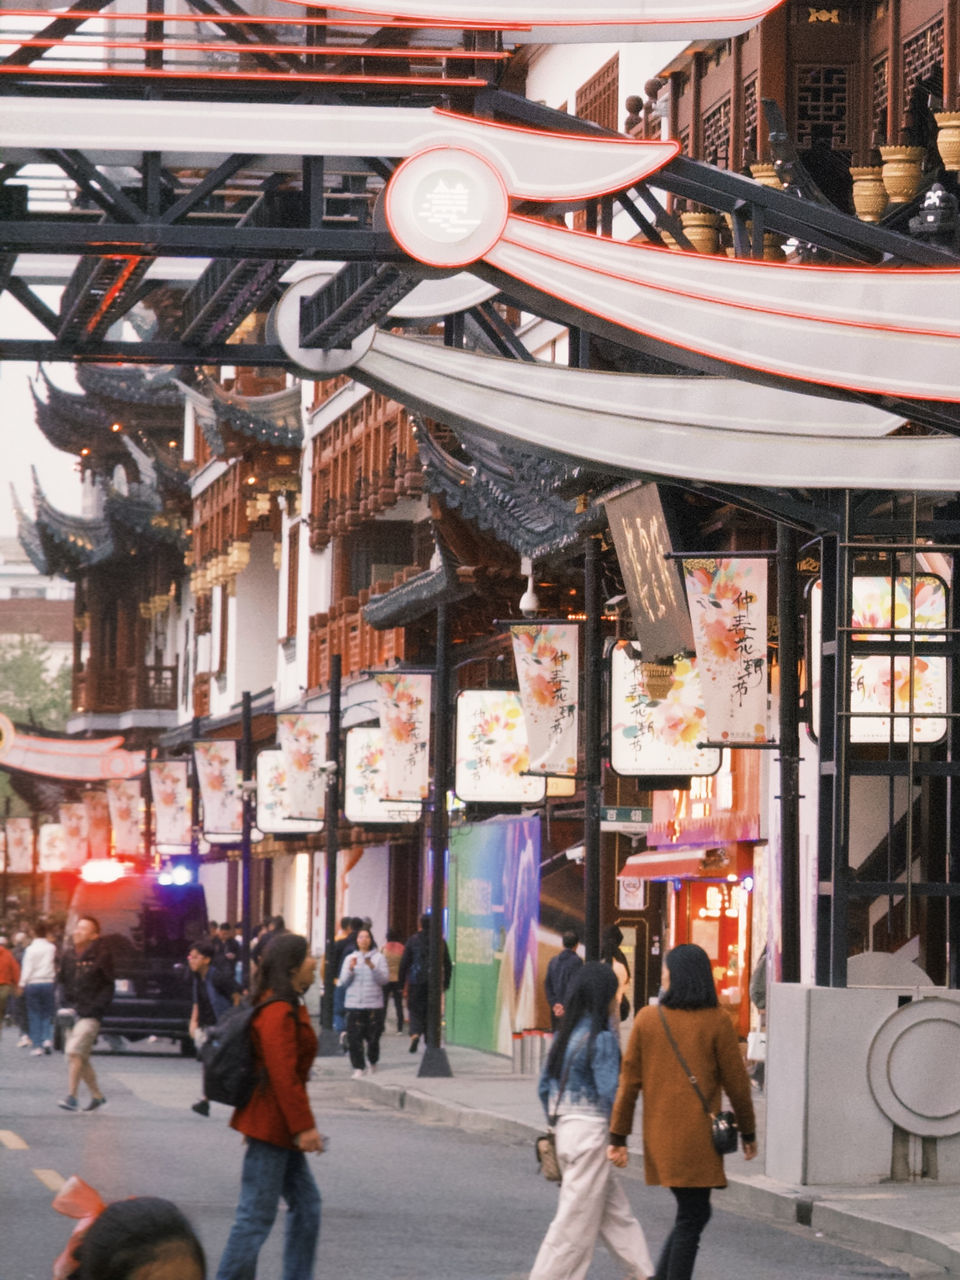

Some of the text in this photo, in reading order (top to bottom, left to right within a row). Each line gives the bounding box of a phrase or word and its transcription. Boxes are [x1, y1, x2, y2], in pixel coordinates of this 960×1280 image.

[727, 589, 763, 708] 仲春花朝节
